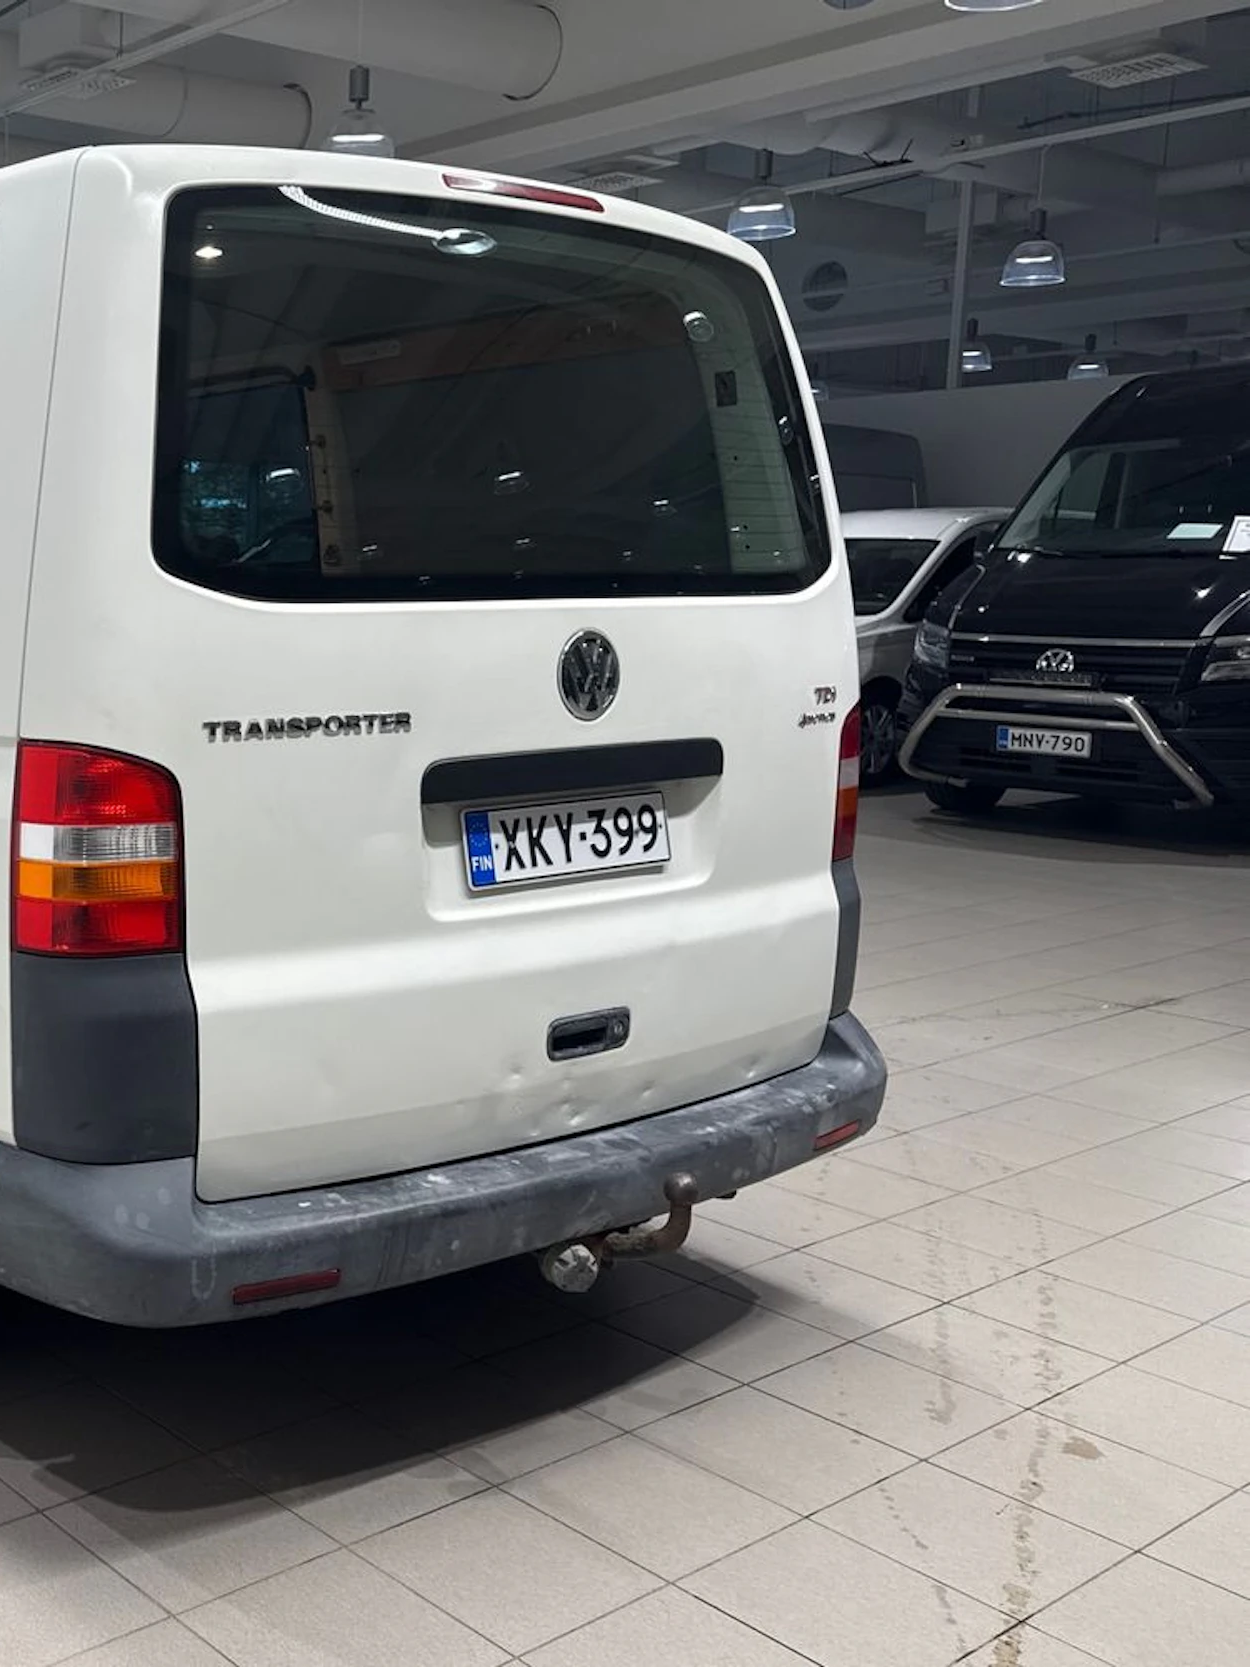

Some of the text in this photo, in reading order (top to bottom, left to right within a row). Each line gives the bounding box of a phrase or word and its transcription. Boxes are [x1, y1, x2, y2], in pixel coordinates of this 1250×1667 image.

[202, 712, 411, 743] TRANSPORTER
[471, 804, 658, 872] FIN XKY-399
